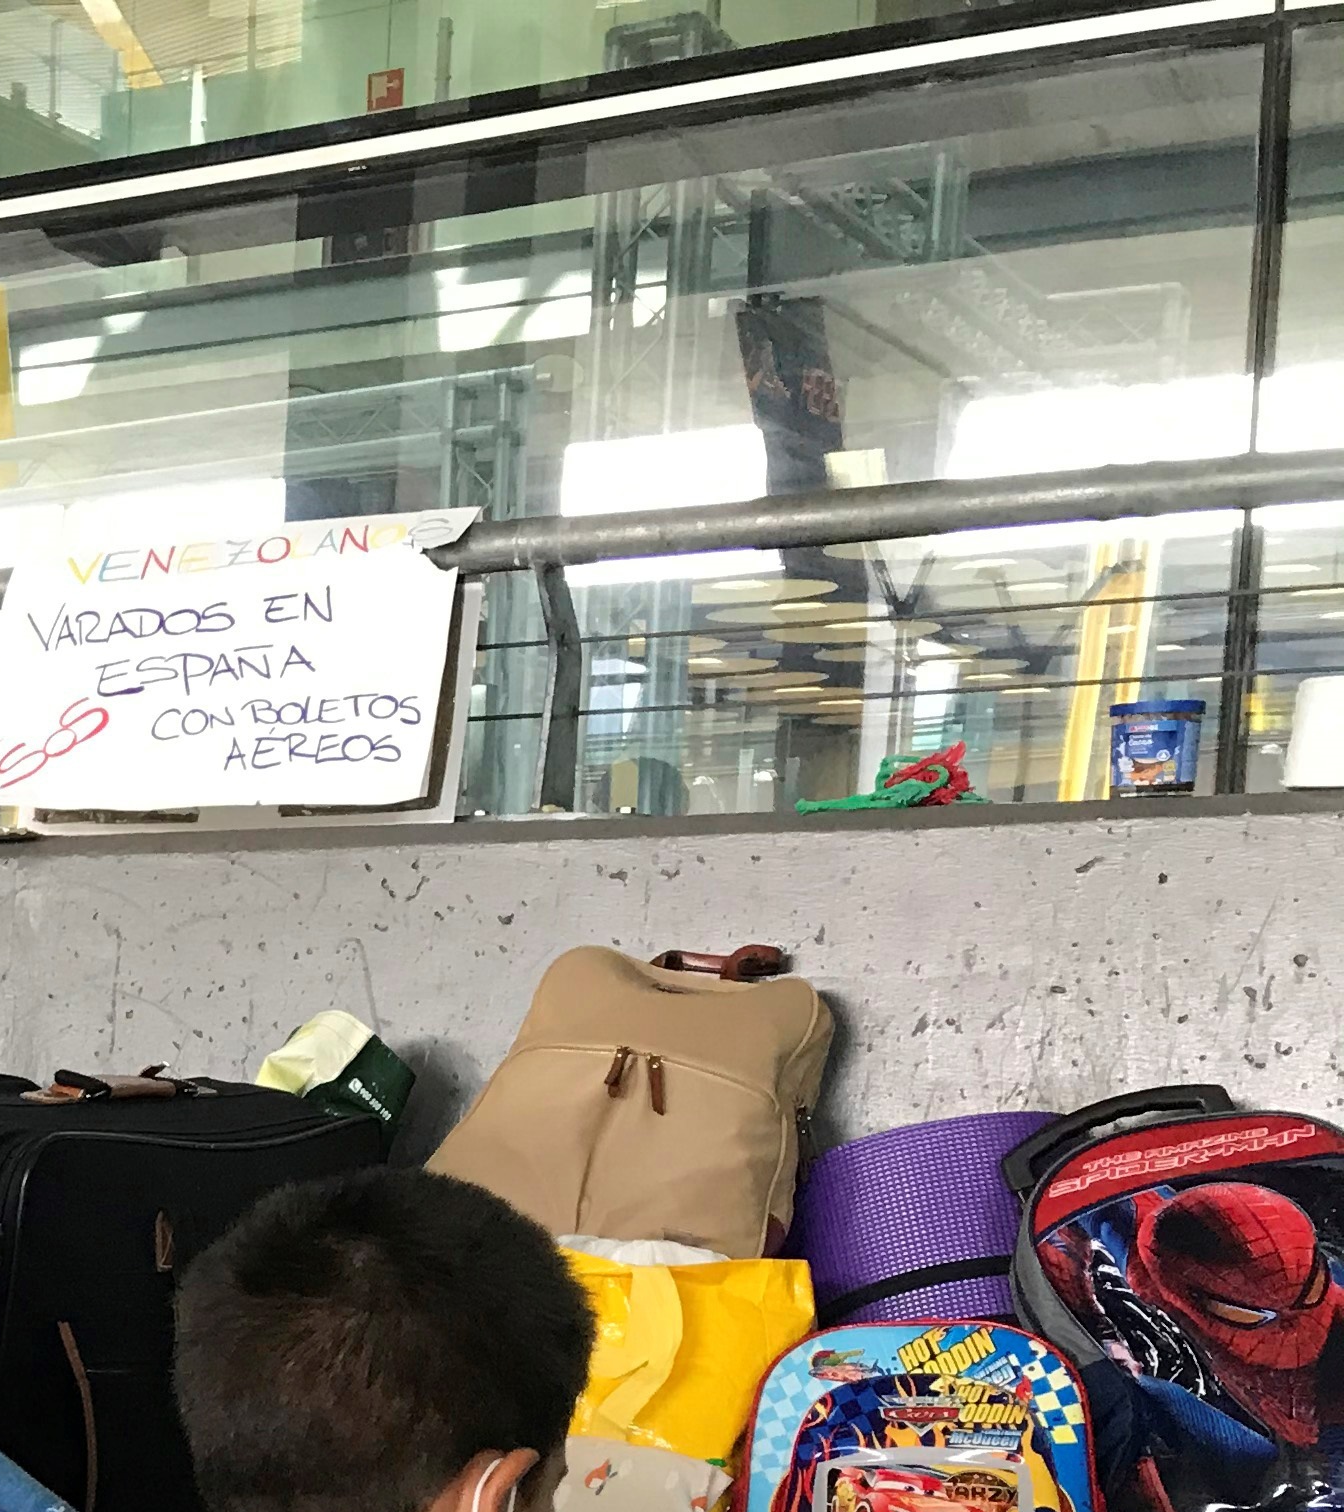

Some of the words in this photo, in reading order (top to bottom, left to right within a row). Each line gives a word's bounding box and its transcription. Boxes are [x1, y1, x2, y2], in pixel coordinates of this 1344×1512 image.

[67, 517, 454, 584] VENEZOLANOS
[27, 602, 235, 651] VARADOS
[263, 586, 334, 624] EN
[95, 643, 316, 698] ESPAÑA
[150, 706, 235, 741] CON
[241, 694, 422, 726] BOLETOS
[223, 728, 402, 771] AÉREOS
[1048, 1123, 1316, 1198] SPIDER-MAN
[1082, 1150, 1142, 1173] THE
[1144, 1126, 1269, 1158] AMAZING
[897, 1329, 943, 1371] HOT
[909, 1327, 997, 1375] ODDIN
[958, 1382, 994, 1403] HOT
[958, 1403, 1028, 1425] ODDIN
